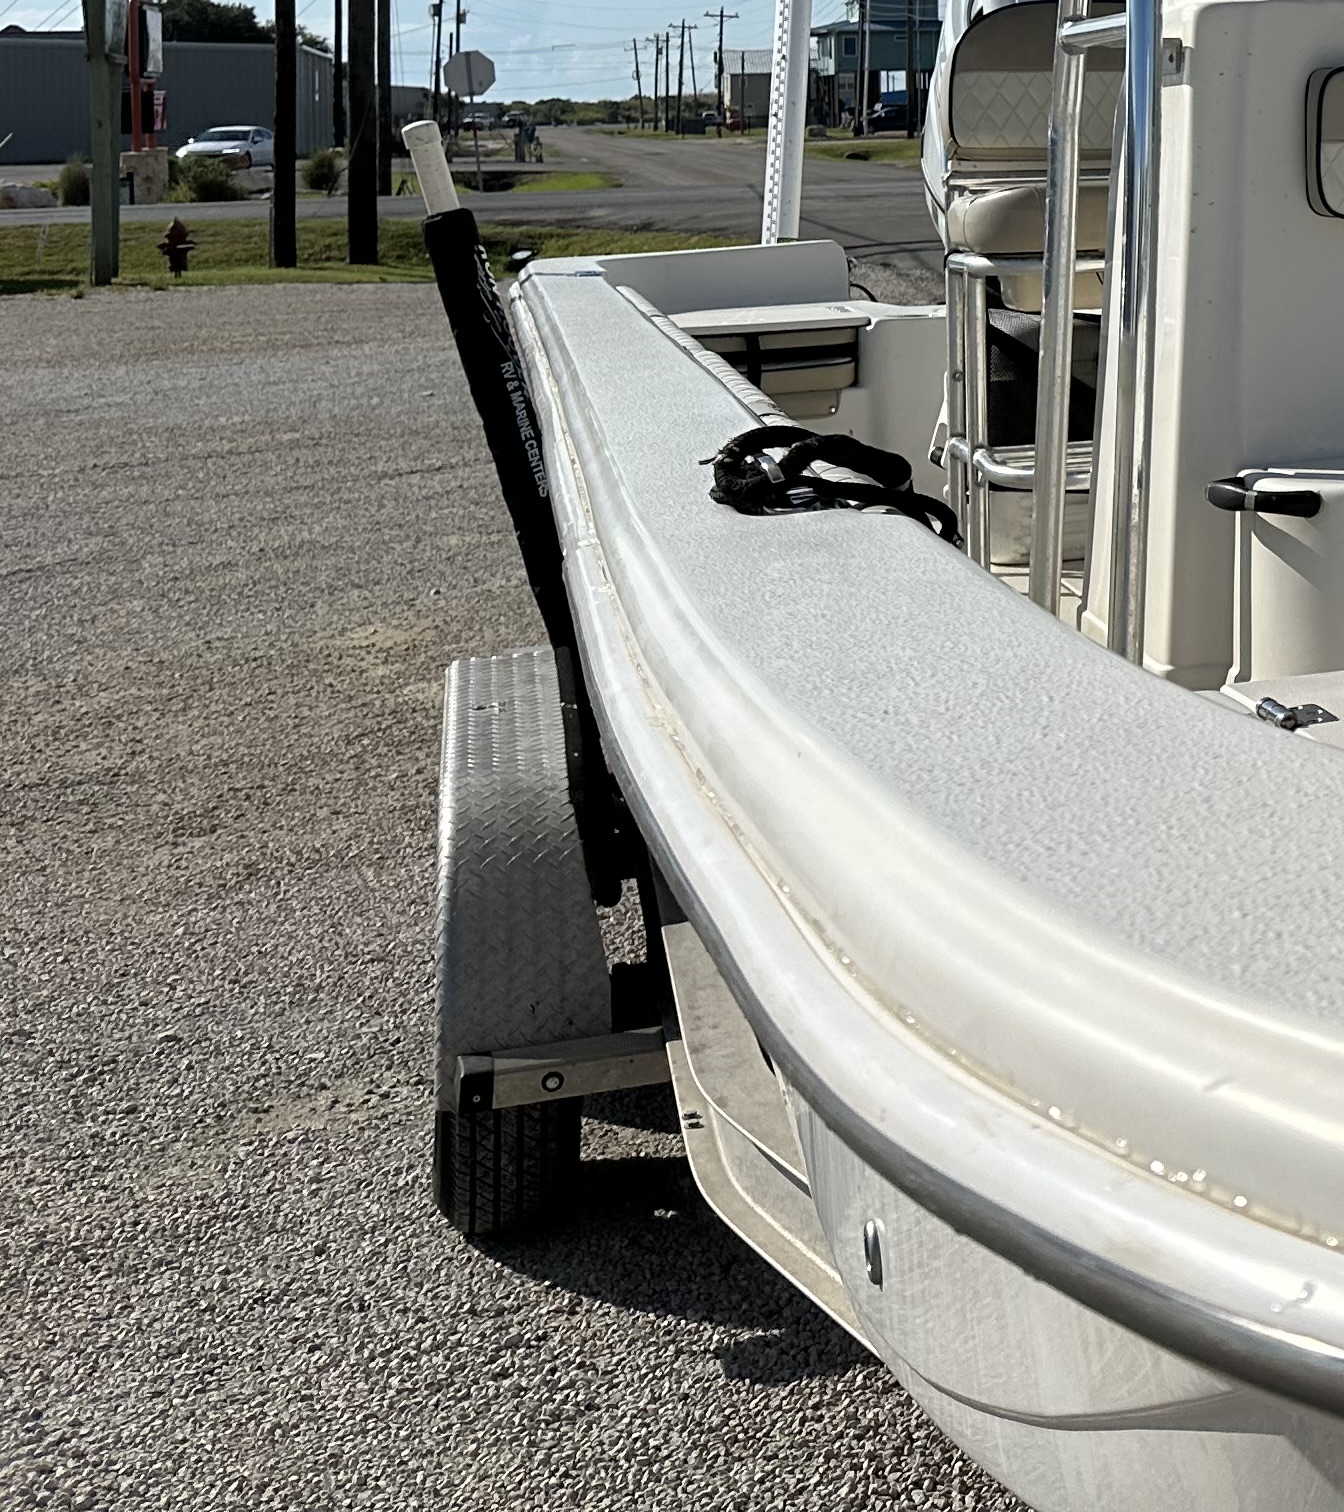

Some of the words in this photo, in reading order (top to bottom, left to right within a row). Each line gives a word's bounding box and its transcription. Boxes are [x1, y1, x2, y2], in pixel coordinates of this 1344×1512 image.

[500, 360, 517, 379] RV
[506, 380, 520, 392] &
[509, 390, 535, 442] MARINE
[524, 439, 548, 499] CENTERS
